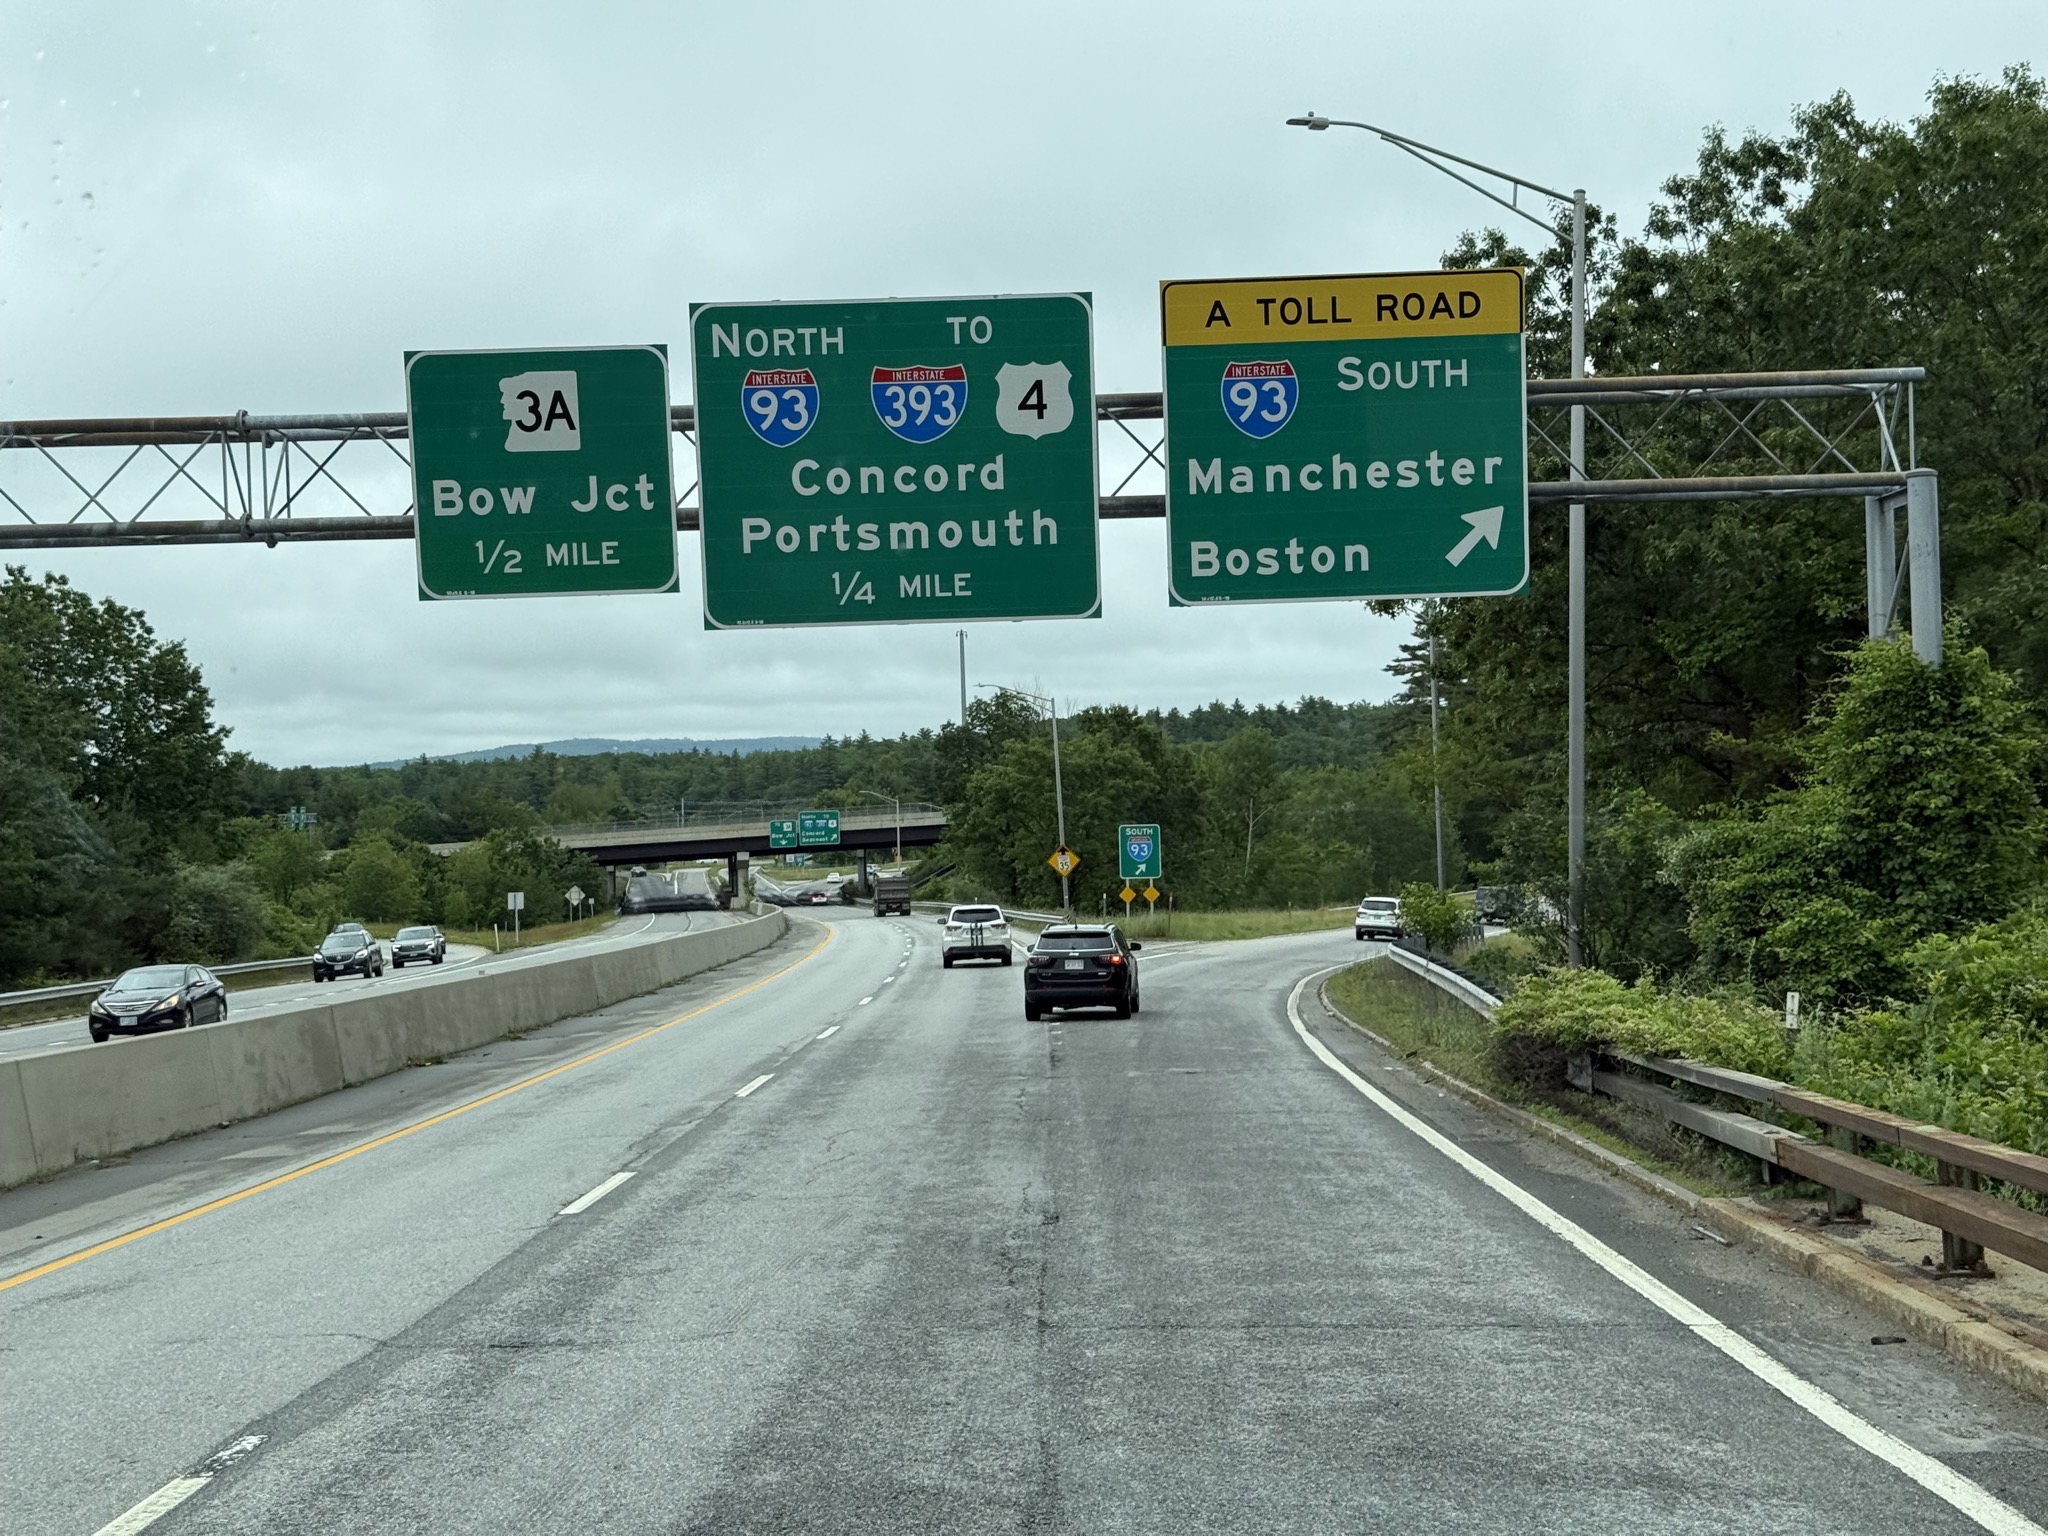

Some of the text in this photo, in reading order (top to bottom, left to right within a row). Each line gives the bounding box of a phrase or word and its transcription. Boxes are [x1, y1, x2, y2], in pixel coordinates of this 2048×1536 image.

[1205, 290, 1481, 328] A TOLL ROAD
[711, 315, 993, 358] NORTH TO
[752, 373, 807, 386] INTERSTATE
[891, 369, 946, 381] INTERSTATE
[1231, 365, 1287, 377] INTERSTATE
[1336, 356, 1468, 391] SOUTH
[515, 390, 577, 433] 3A
[750, 389, 809, 431] 93
[884, 384, 958, 428] 393
[1017, 379, 1048, 420] 4
[1229, 380, 1288, 423] 93
[791, 453, 1005, 497] Concord
[1188, 449, 1503, 495] Manchester
[432, 472, 655, 517] Bow Jct
[741, 509, 1058, 555] Portsmouth
[546, 541, 620, 567] MILE
[1190, 537, 1370, 578] Boston
[899, 573, 972, 599] MILE
[1059, 861, 1070, 871] 35
[1131, 844, 1148, 856] 93
